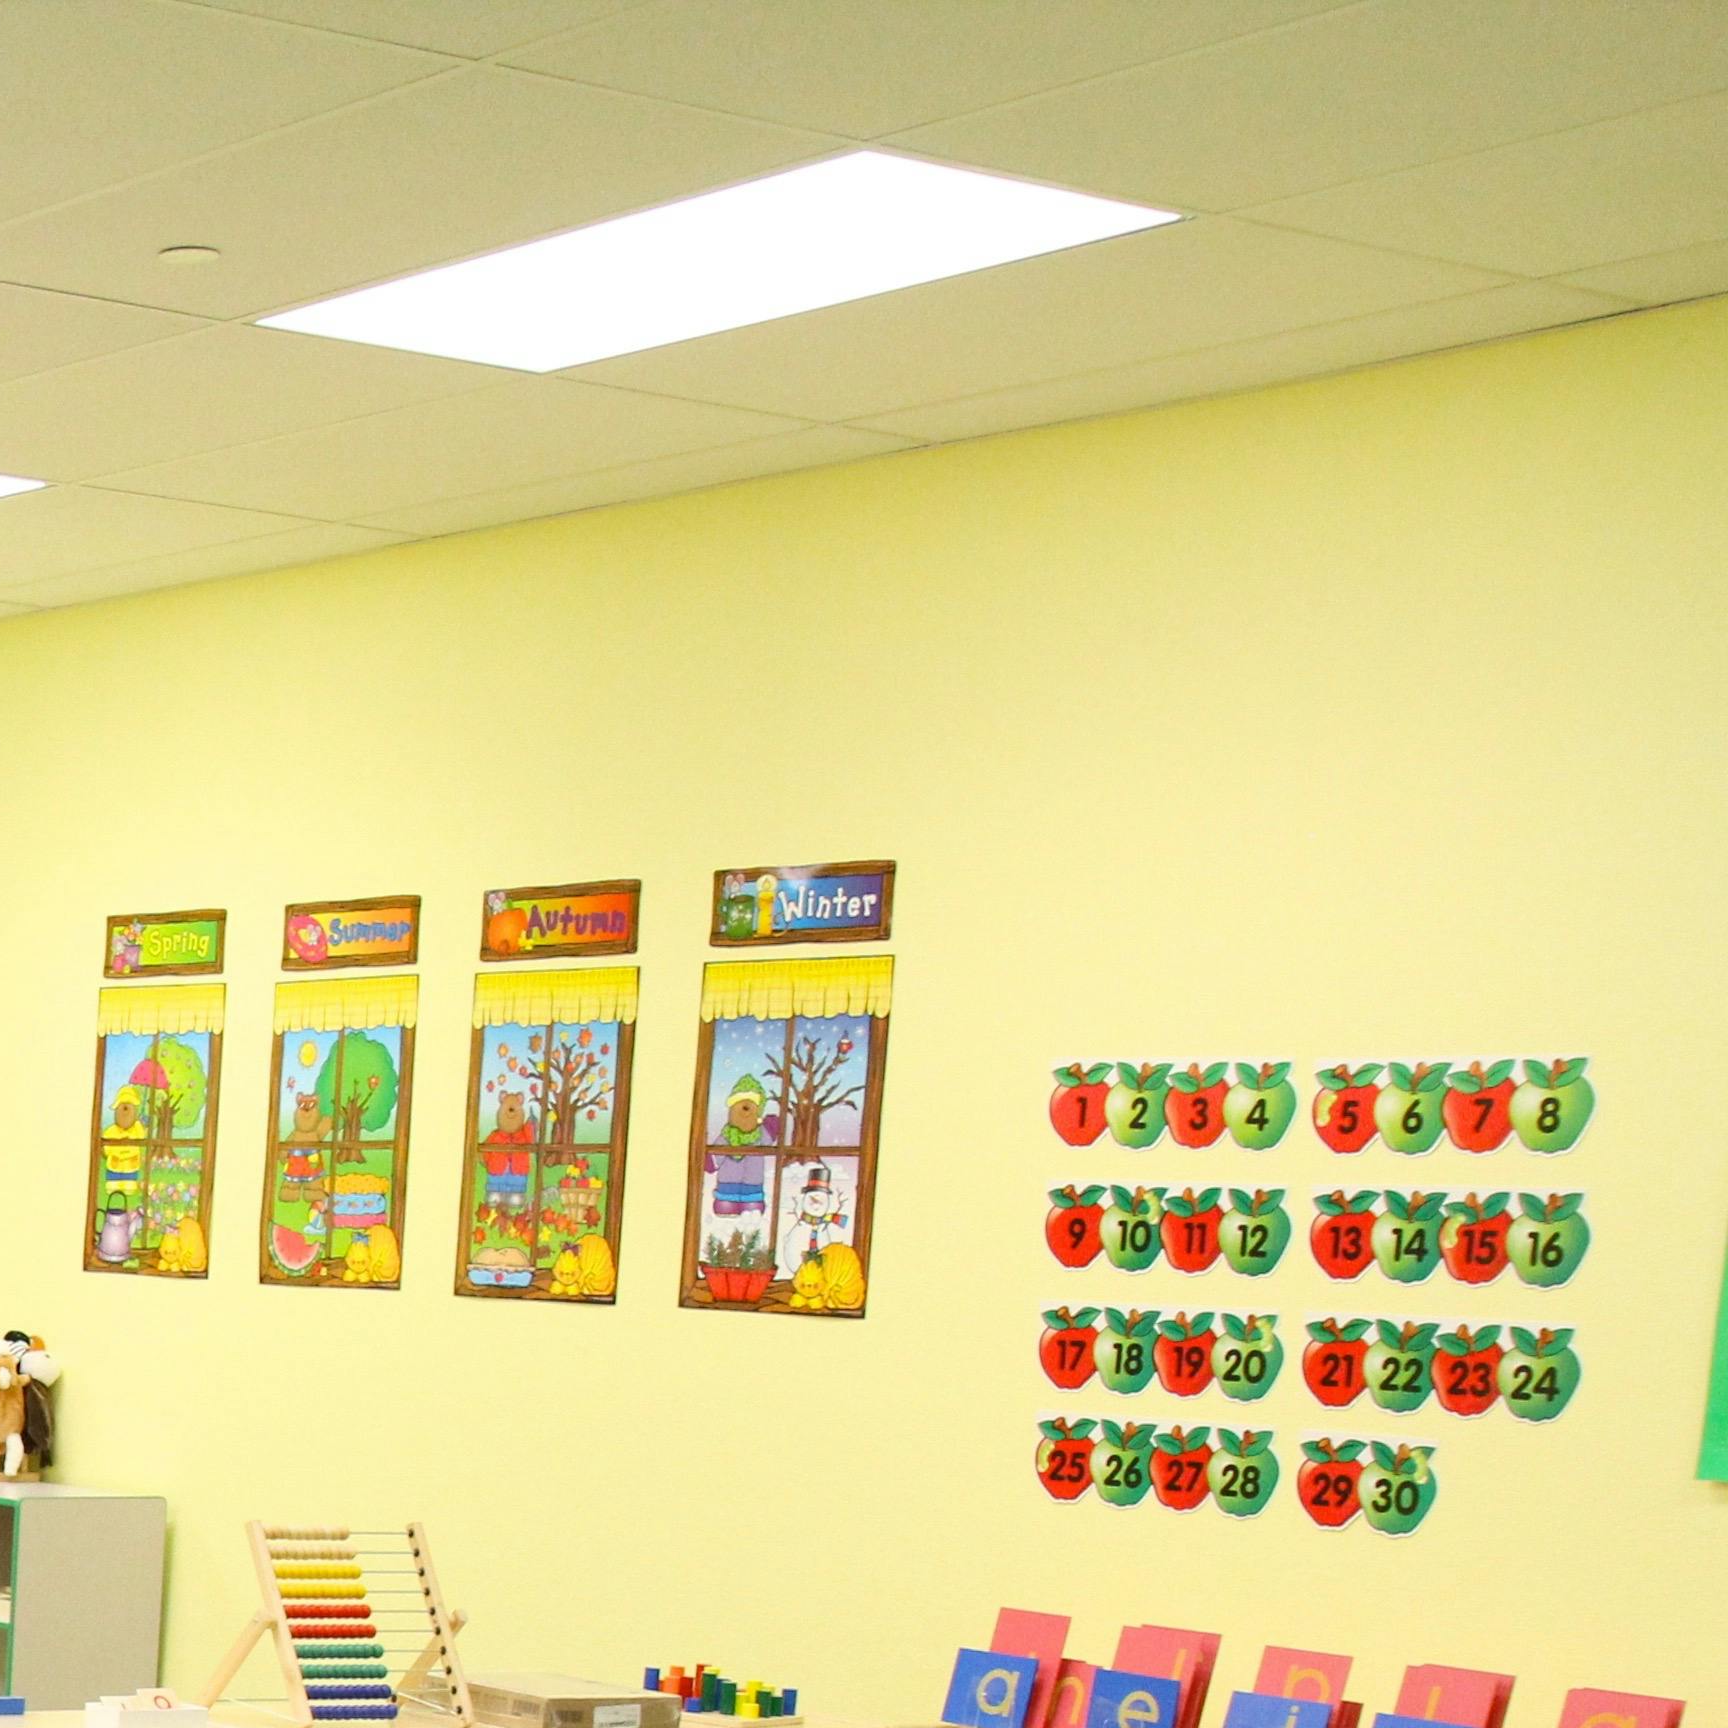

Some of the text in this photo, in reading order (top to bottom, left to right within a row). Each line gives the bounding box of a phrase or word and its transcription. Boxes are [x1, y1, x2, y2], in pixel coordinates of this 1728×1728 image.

[526, 904, 626, 945] Autumn
[779, 886, 878, 923] Winter
[148, 929, 211, 959] Spring
[329, 917, 411, 947] Summer
[1075, 1096, 1270, 1132] 1 2 3 4
[1339, 1097, 1561, 1135] 5 6 7 8
[1068, 1218, 1269, 1259] 9 10 11 12
[1330, 1226, 1565, 1269] 13 14 15 16
[1058, 1340, 1268, 1385] 17 18 19 20
[1320, 1353, 1561, 1403] 21 22 23 24
[1049, 1451, 1261, 1500] 25 26 27 28
[1311, 1472, 1421, 1517] 29 30
[976, 1668, 1020, 1717] a
